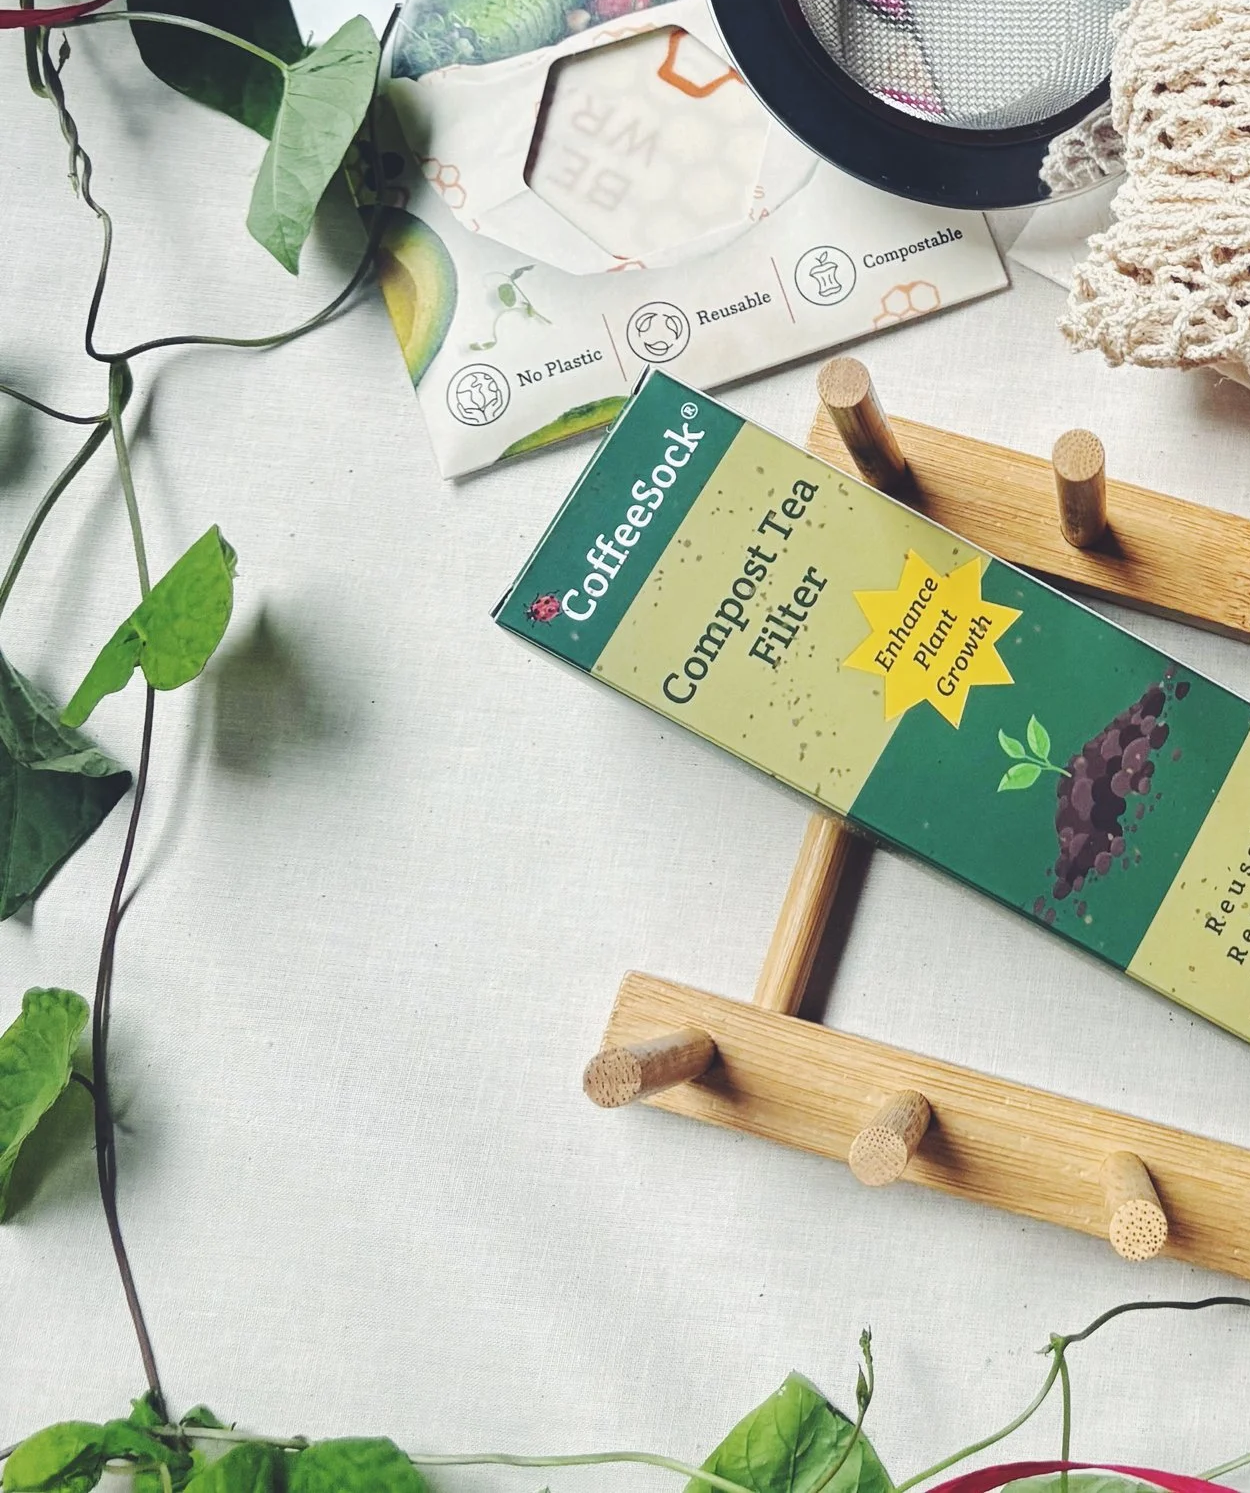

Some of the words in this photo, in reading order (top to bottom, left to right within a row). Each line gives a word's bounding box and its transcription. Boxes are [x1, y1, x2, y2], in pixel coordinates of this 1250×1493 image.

[863, 227, 963, 269] Compostable
[696, 291, 772, 325] Reusable
[517, 370, 543, 387] No
[544, 349, 603, 378] Plastic
[662, 543, 778, 705] Compost
[759, 476, 819, 542] Tea
[749, 564, 828, 670] Filter
[875, 576, 938, 673] Enhance
[912, 608, 958, 671] Plant
[936, 614, 993, 698] Growth
